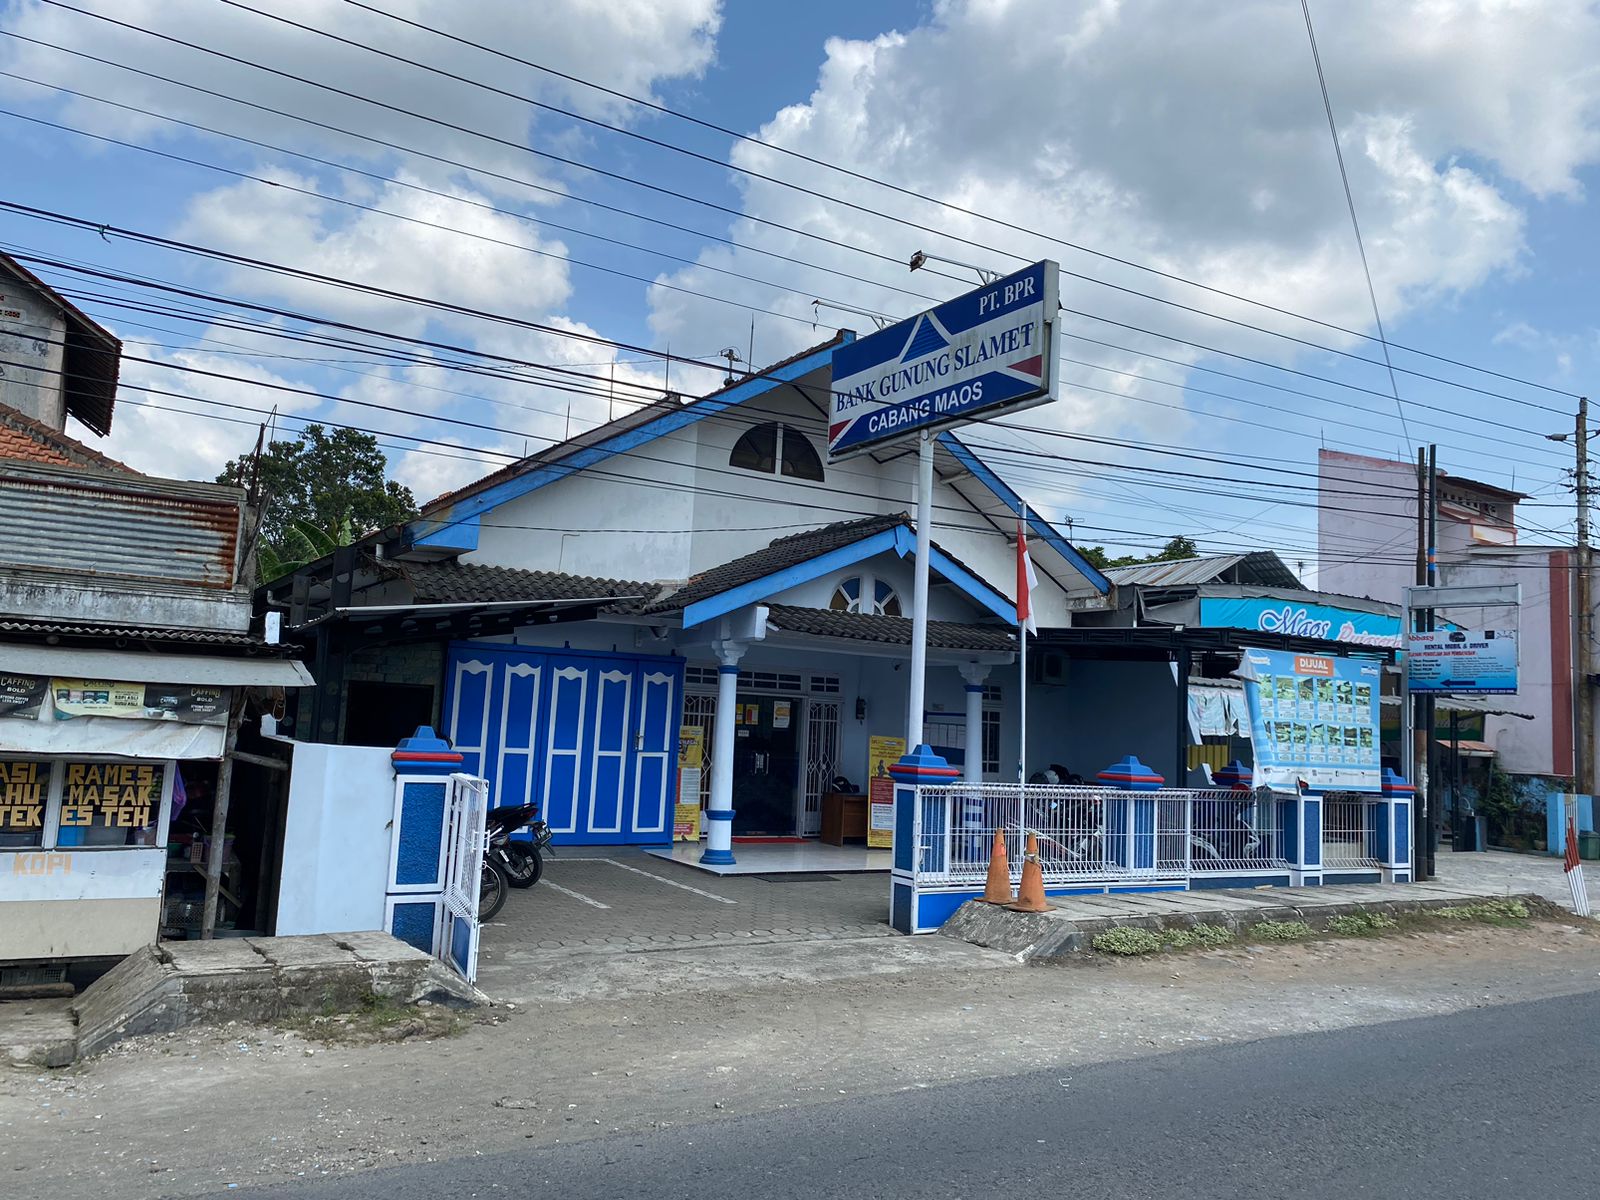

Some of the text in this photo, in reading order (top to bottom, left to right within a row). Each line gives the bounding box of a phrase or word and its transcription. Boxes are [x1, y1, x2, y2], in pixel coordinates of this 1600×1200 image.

[978, 276, 1036, 317] PT. BPR
[835, 322, 1035, 413] BANK GUNUNG SLAMET
[868, 381, 983, 434] CABANG MAOS
[1259, 607, 1330, 638] Maos
[1299, 657, 1329, 670] DIJUAL
[0, 677, 36, 690] CAFFINO
[6, 686, 26, 694] BOLD
[190, 687, 221, 699] CAFFINO
[68, 763, 154, 785] RAMES
[0, 783, 152, 806] HU MASAK
[60, 805, 94, 826] ES
[101, 806, 150, 827] TEH
[13, 852, 73, 876] KOPI
